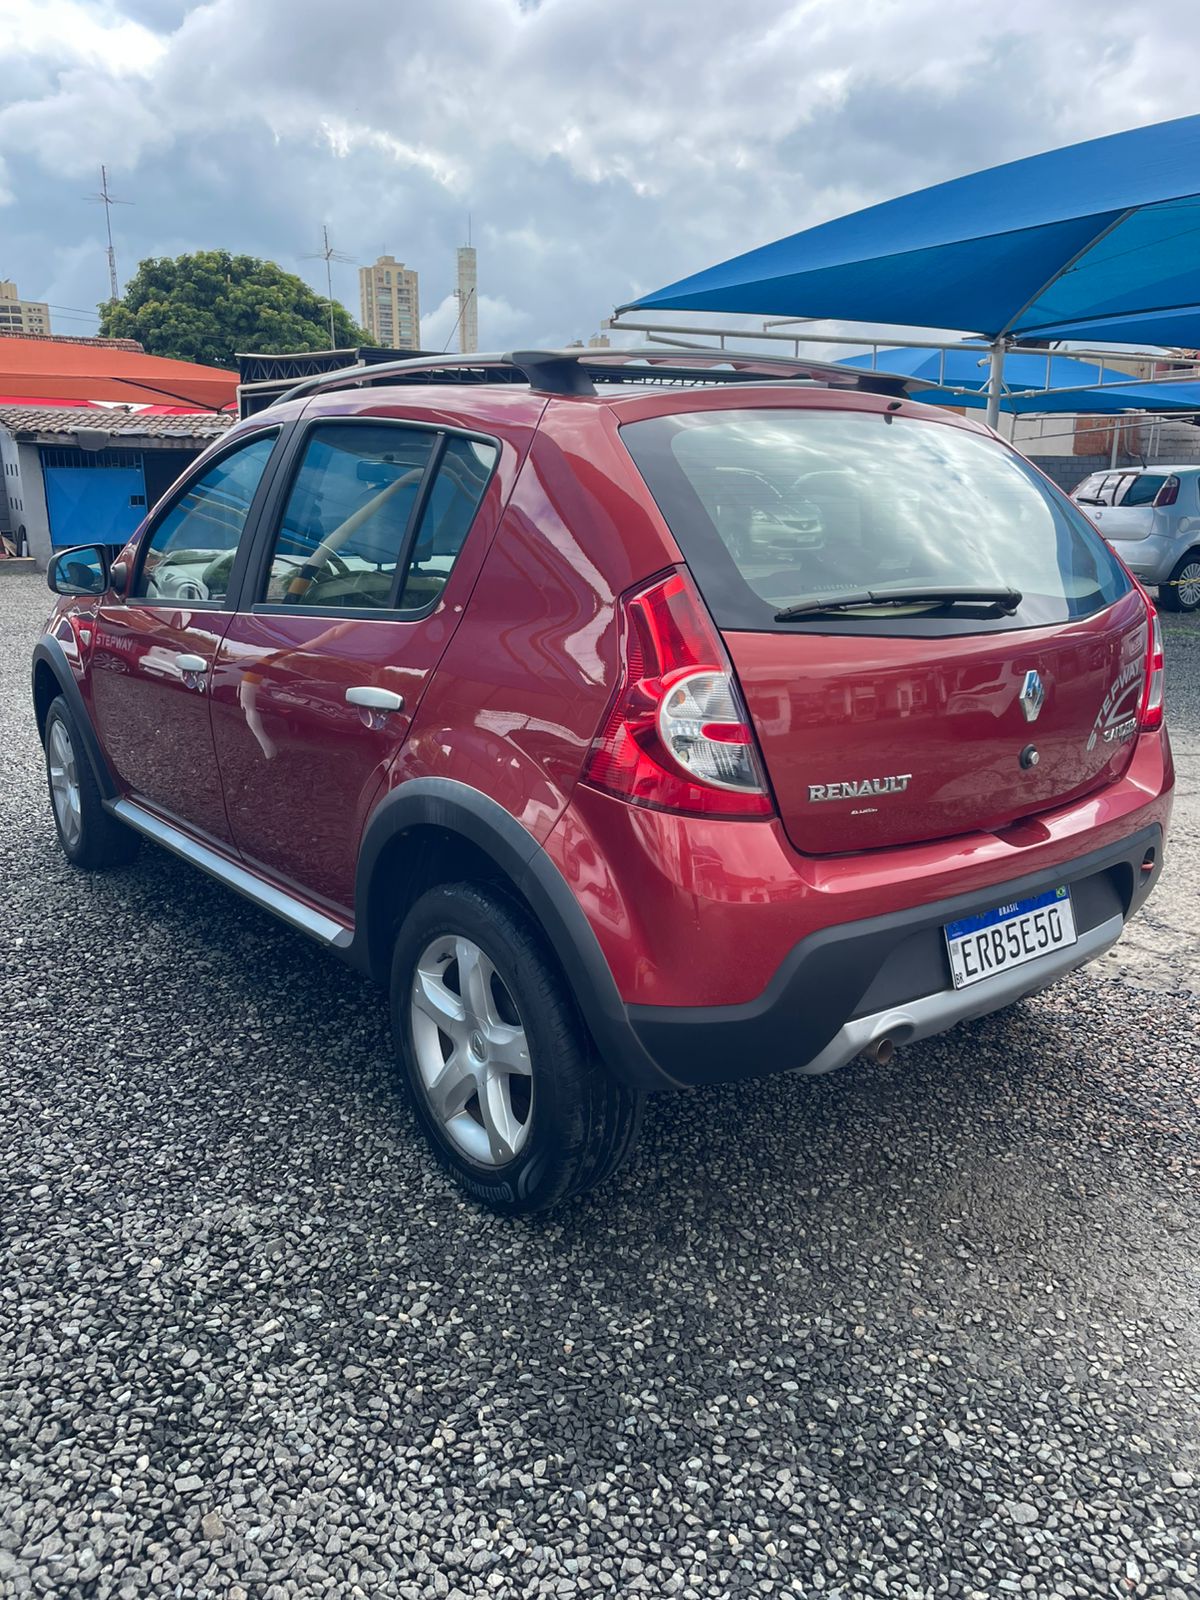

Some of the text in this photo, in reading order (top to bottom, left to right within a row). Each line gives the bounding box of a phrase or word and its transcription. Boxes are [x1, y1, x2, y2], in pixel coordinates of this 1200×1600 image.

[96, 633, 132, 651] STEPWAY
[1086, 661, 1140, 752] STEPWAY
[808, 773, 912, 802] RENAULT
[998, 902, 1019, 916] BRASIL
[961, 908, 1062, 977] ERB5E50
